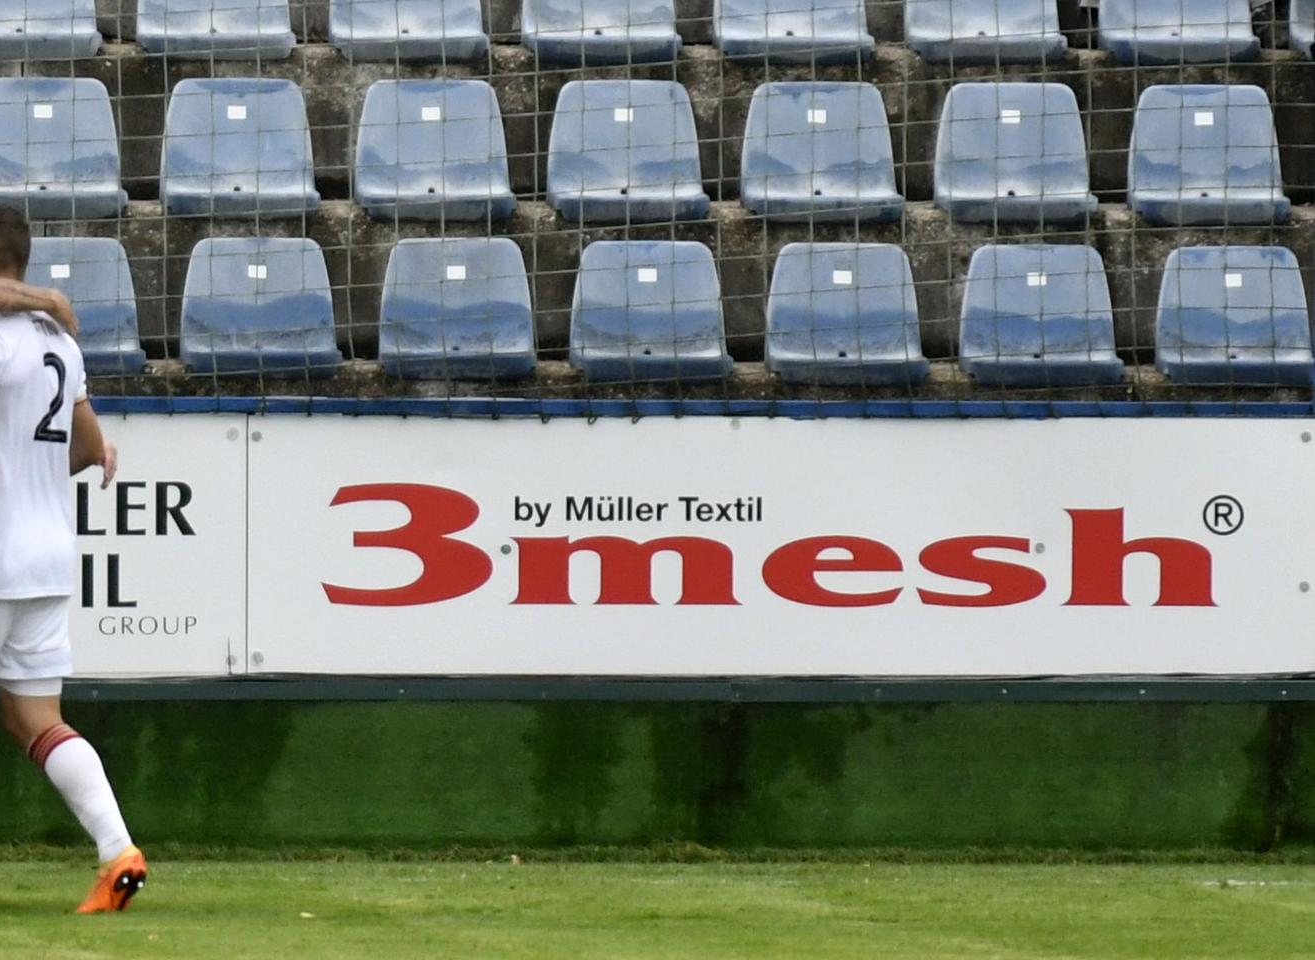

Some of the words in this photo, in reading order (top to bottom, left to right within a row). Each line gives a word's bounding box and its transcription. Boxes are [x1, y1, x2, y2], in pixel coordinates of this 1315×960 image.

[34, 351, 68, 444] 2
[76, 480, 197, 536] LER
[514, 496, 552, 527] by
[565, 496, 669, 522] Müller
[678, 496, 764, 522] Textil
[81, 553, 138, 608] IL
[98, 615, 198, 636] GROUP
